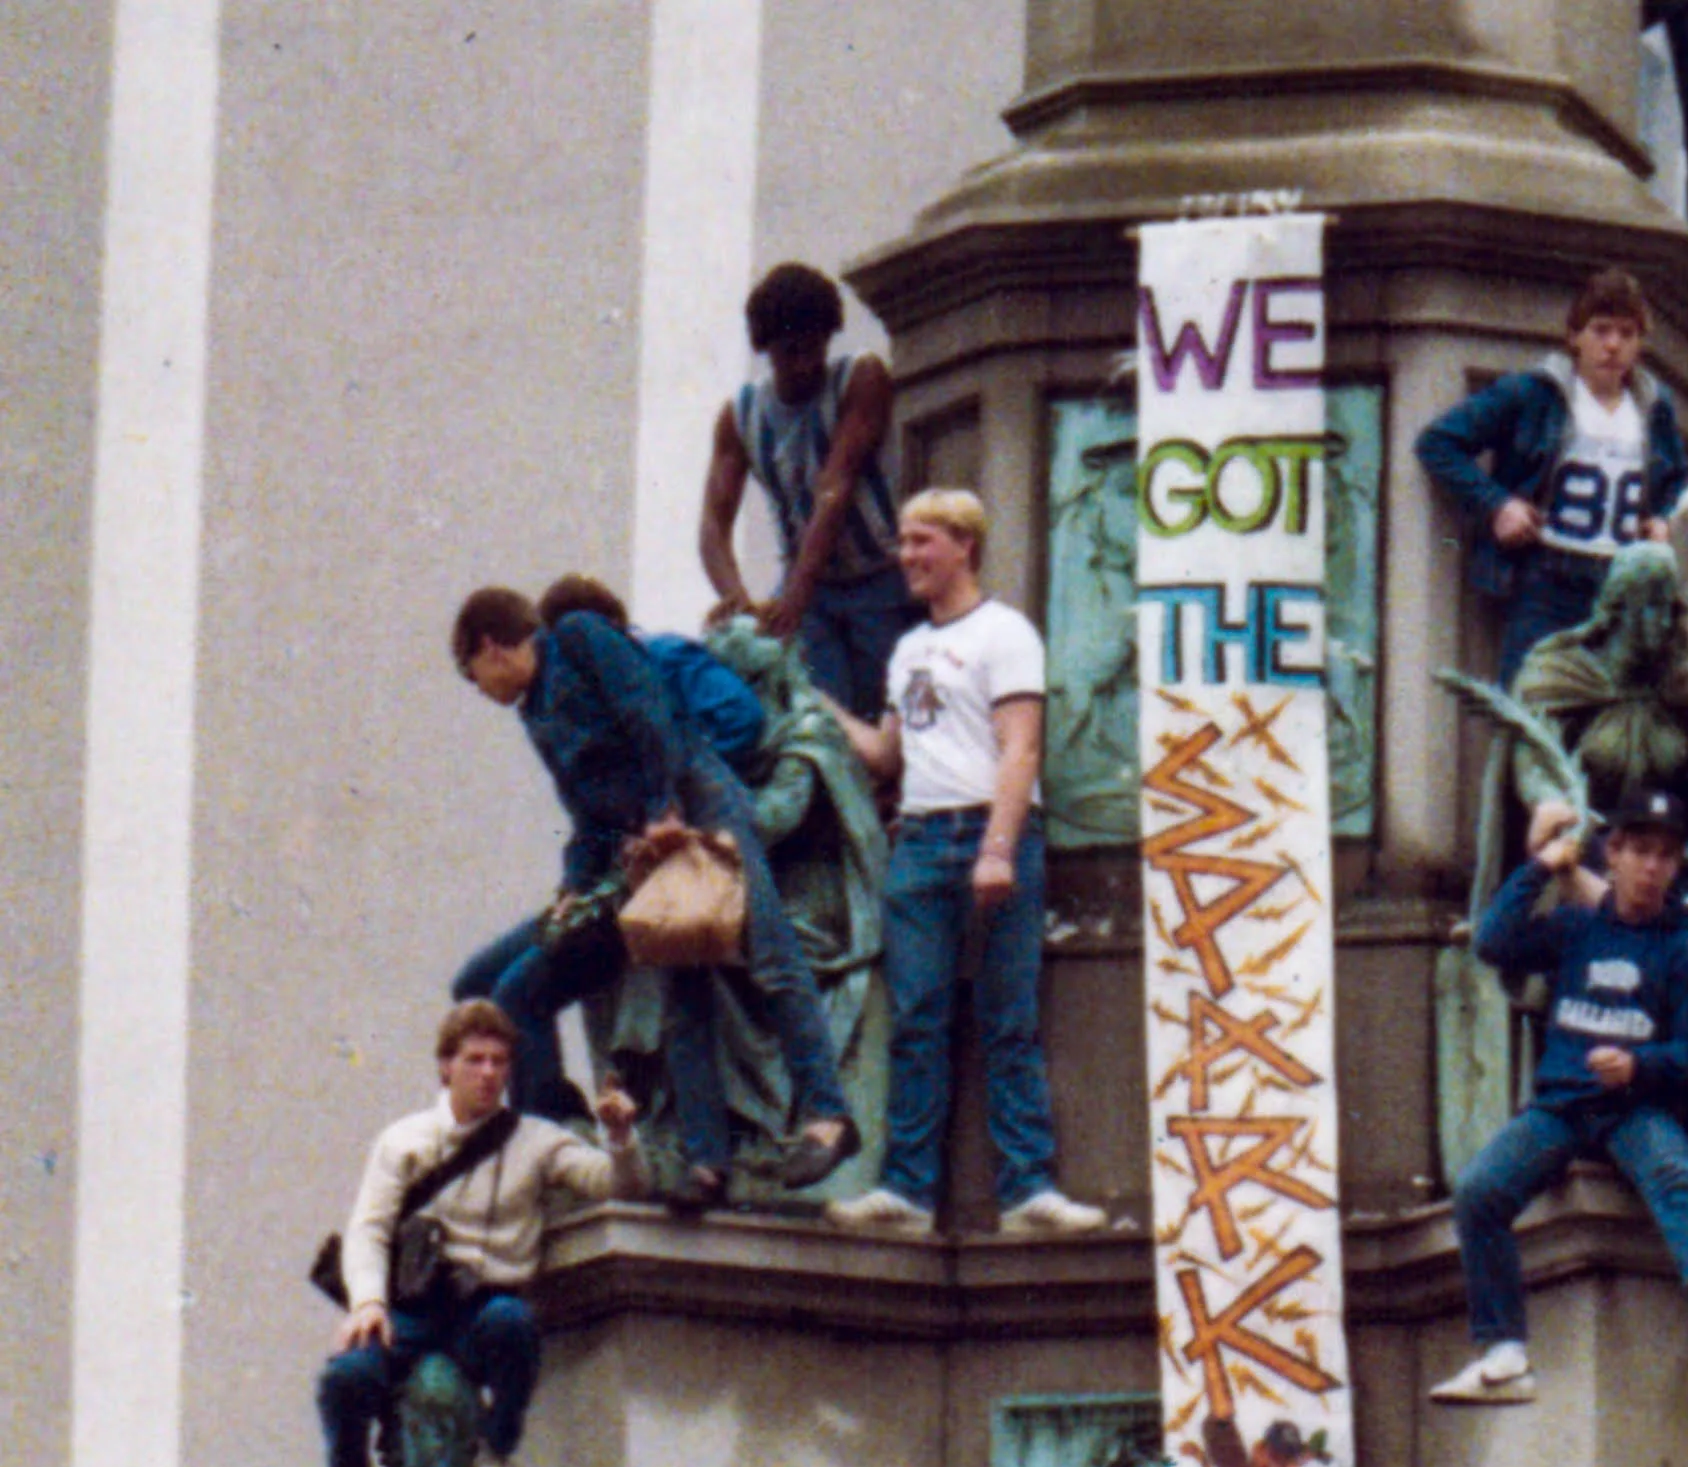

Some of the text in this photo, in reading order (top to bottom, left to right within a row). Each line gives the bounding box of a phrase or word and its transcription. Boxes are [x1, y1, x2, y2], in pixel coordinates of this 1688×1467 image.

[1138, 276, 1325, 391] WE
[1137, 438, 1325, 537] GOT
[1137, 583, 1325, 687] THE
